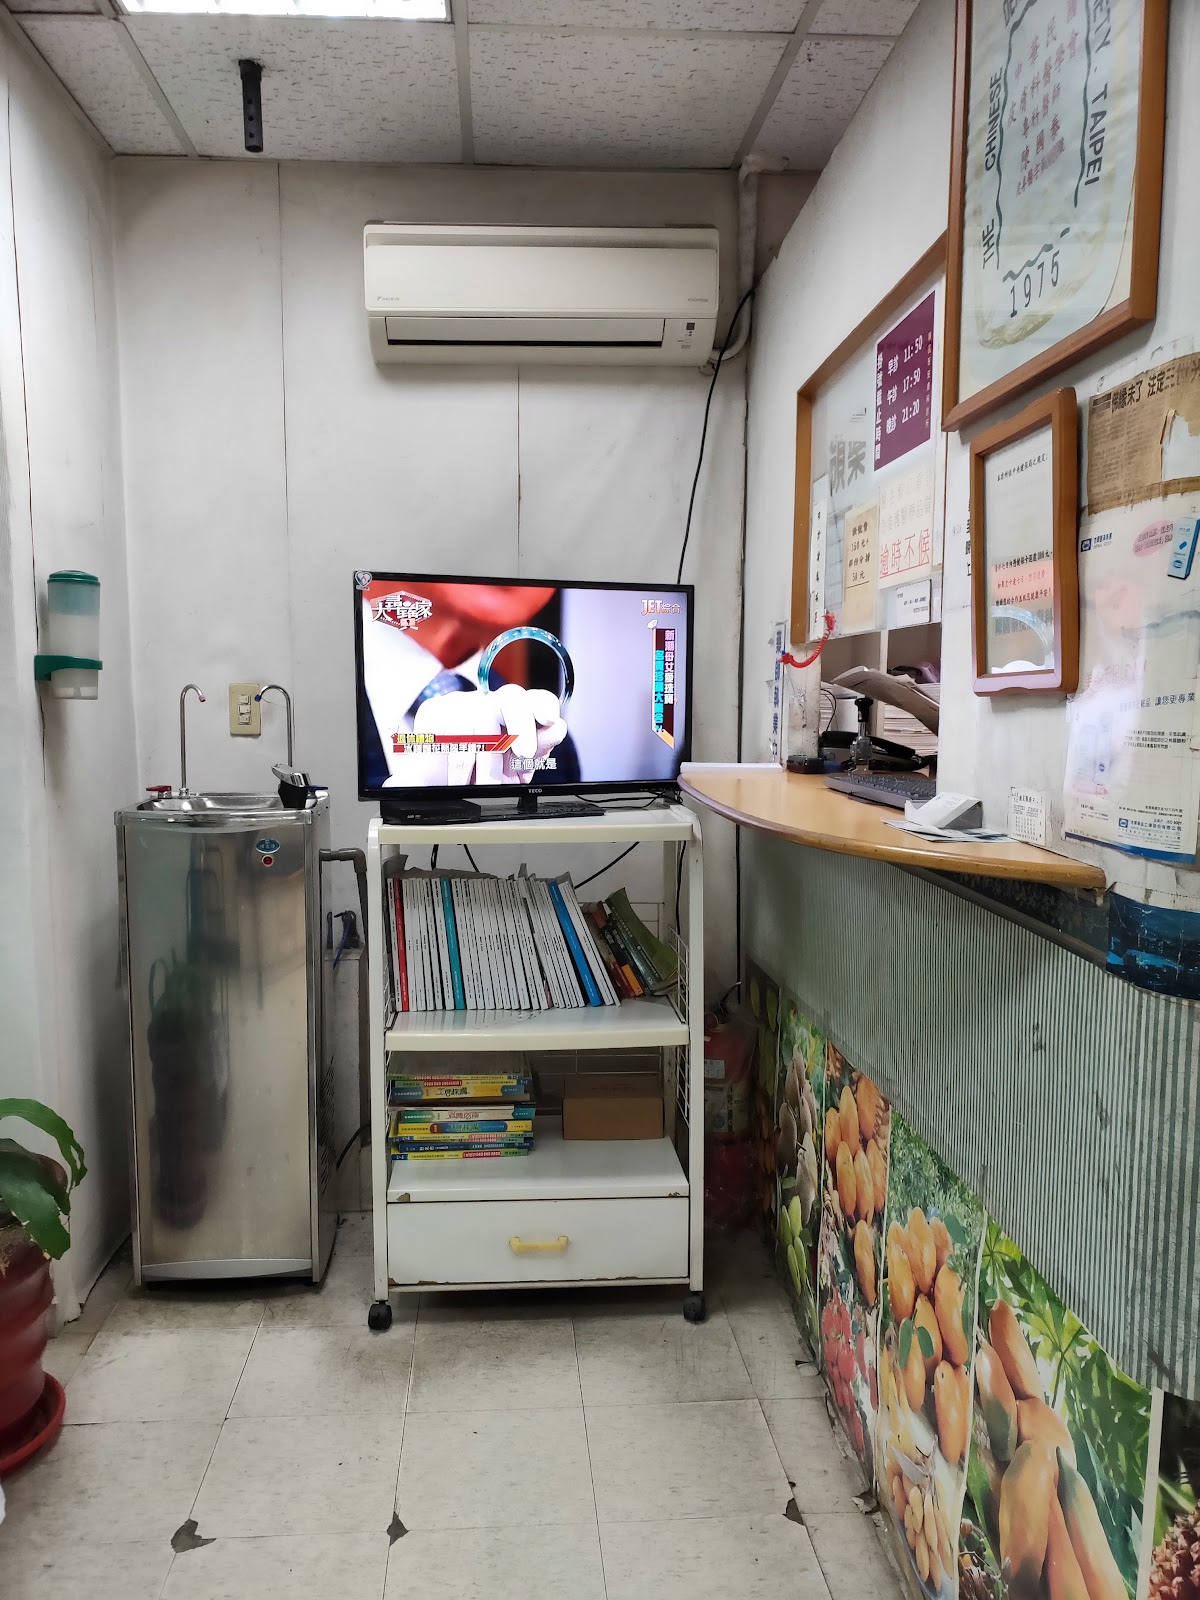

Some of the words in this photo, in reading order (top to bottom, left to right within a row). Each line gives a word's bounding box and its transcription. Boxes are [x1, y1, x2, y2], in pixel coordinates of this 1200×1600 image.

[984, 67, 1003, 172] CHINESE
[1085, 82, 1108, 186] TAIPEI
[982, 218, 995, 270] THE
[1010, 249, 1060, 318] 1975
[887, 354, 899, 377] 早診
[903, 334, 923, 364] 11:50
[874, 352, 883, 461] 掛號截止時間
[886, 385, 898, 406] 午診
[902, 367, 921, 394] 17:50
[885, 414, 897, 435] 晚診
[901, 398, 920, 424] 21:20
[880, 528, 930, 576] 逾時不候
[511, 757, 557, 770] 這個就是
